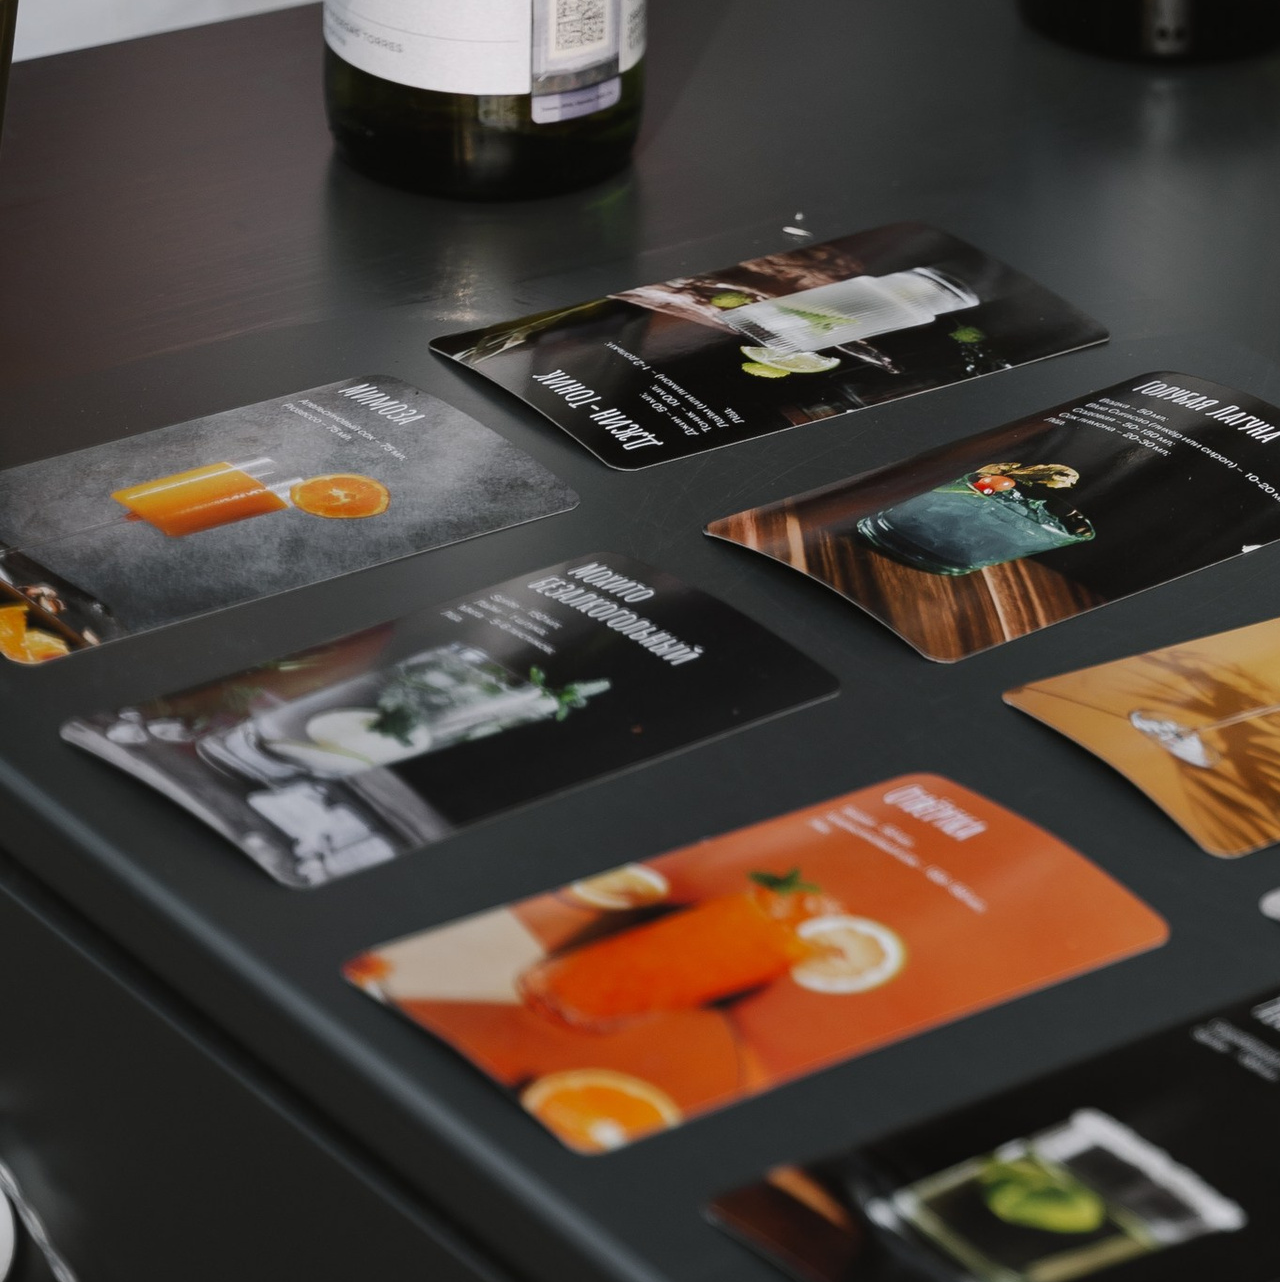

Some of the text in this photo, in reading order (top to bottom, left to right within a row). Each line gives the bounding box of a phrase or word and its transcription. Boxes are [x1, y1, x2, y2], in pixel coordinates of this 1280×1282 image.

[338, 383, 425, 426] МИМОЗА
[662, 393, 681, 407] 100
[1099, 397, 1131, 410] Водка
[1137, 408, 1154, 416] 50
[1132, 380, 1220, 411] ГОЛУБАЯ
[651, 401, 668, 414] 50
[705, 408, 730, 429] Лайм
[326, 424, 341, 433] 75
[670, 416, 700, 436] Джин
[685, 411, 712, 433] Тоник
[1058, 412, 1077, 421] Сок
[1078, 418, 1116, 432] лимона
[1122, 432, 1156, 448] 20-30
[357, 429, 377, 441] сок
[380, 442, 395, 452] 75
[1148, 422, 1183, 442] (ликёр
[1181, 436, 1202, 449] или
[1201, 446, 1238, 469] сироп)
[1244, 472, 1276, 494] 10-20
[568, 561, 655, 603] МОХИТО
[527, 575, 704, 666] БЕЗАЛКОГОЛЬНЫЙ
